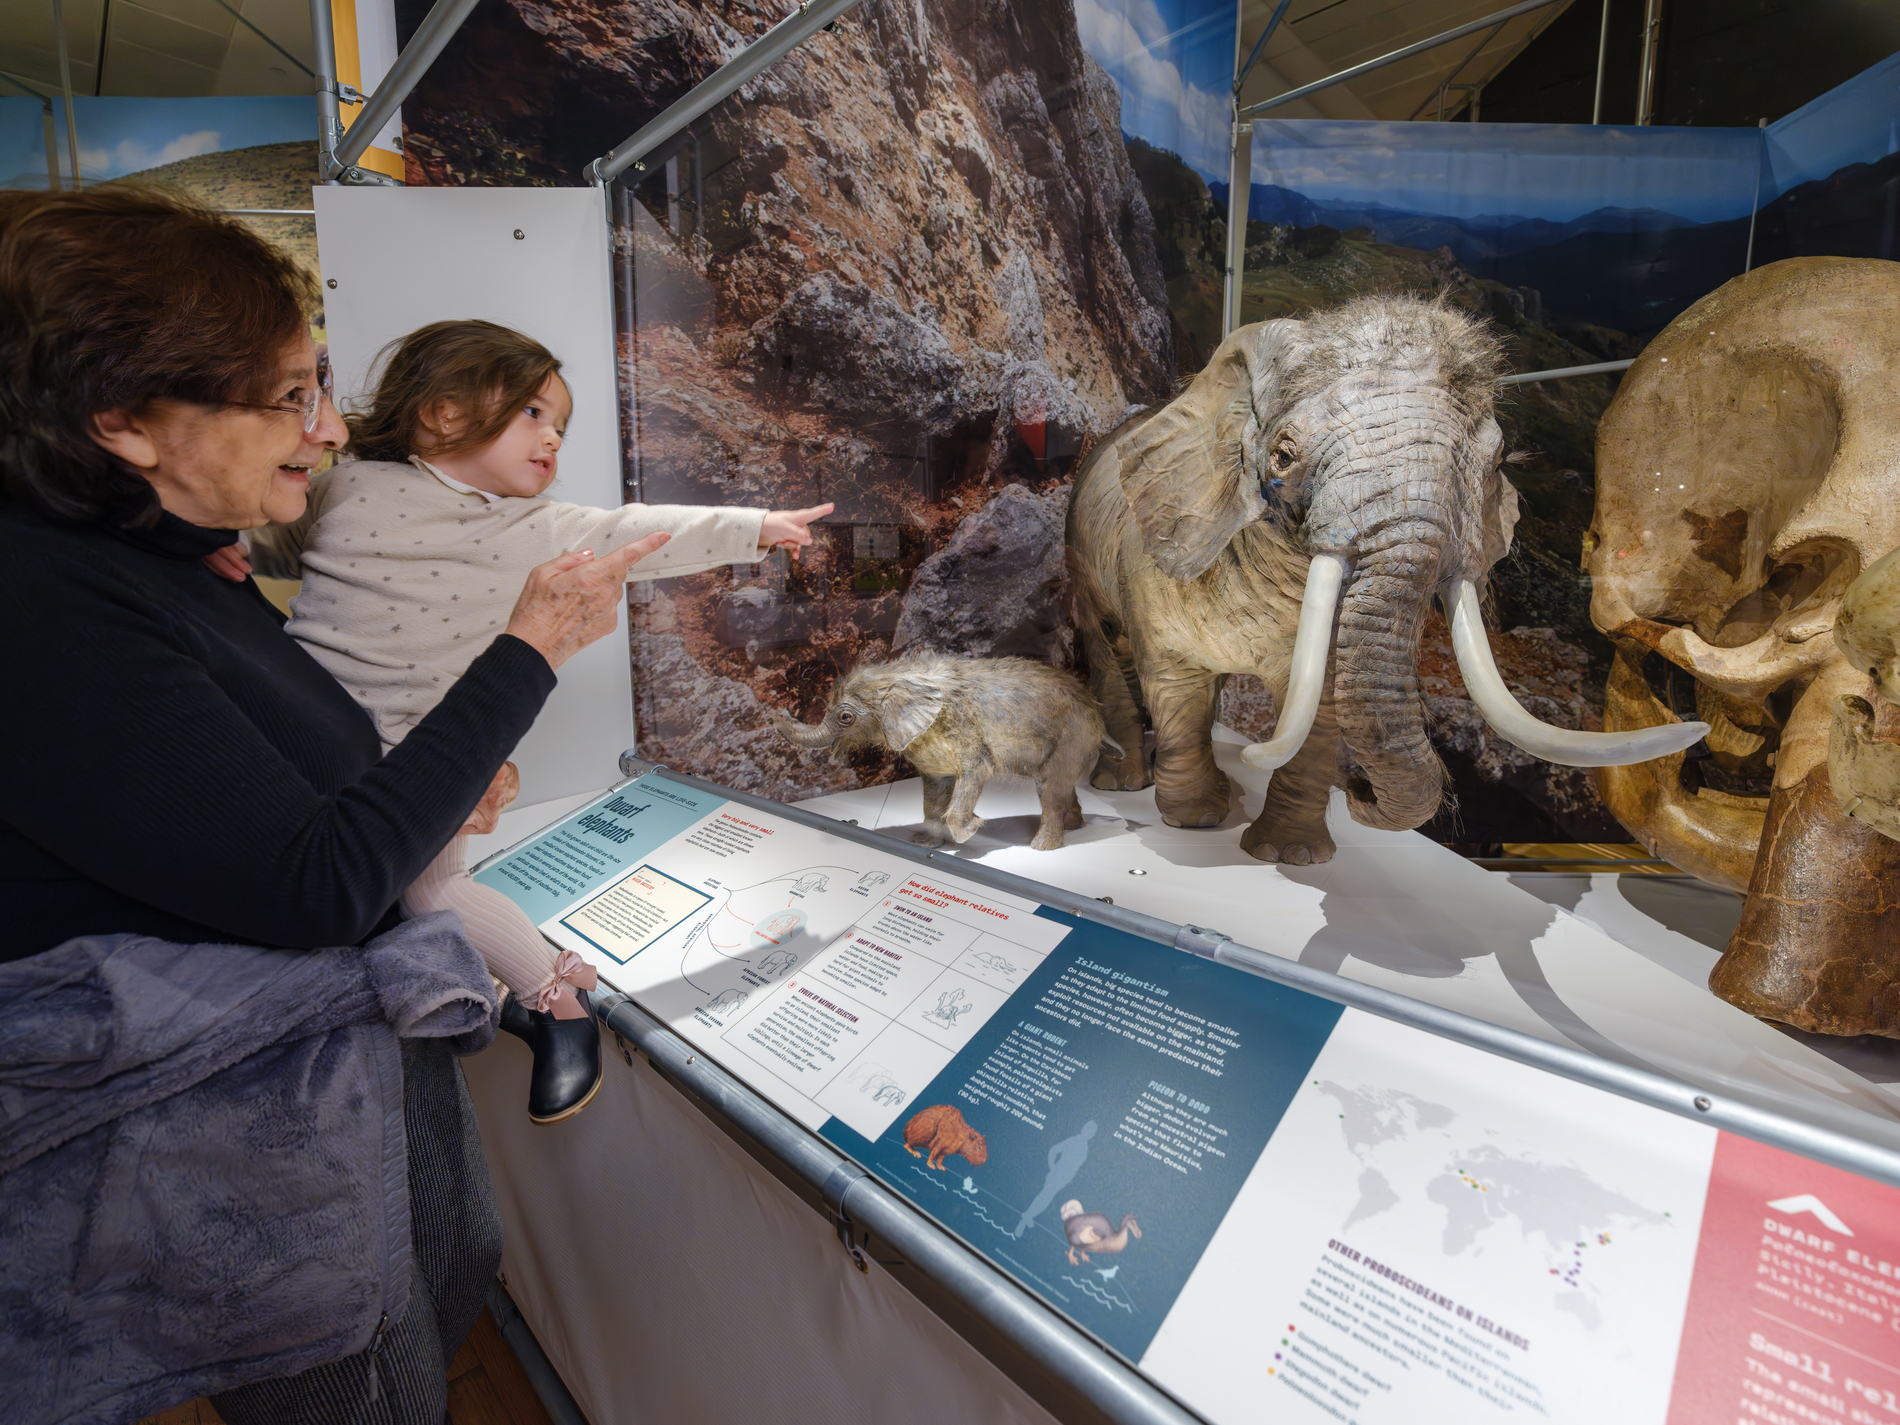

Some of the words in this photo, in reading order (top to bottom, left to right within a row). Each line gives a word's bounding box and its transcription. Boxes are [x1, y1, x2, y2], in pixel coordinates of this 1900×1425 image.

[603, 795, 651, 818] Dwarf
[577, 811, 635, 844] elephants
[758, 827, 775, 835] small
[907, 880, 921, 888] How
[920, 885, 936, 893] did
[934, 890, 968, 905] elephant
[968, 902, 1009, 920] relatives
[916, 913, 932, 923] ISLAND
[922, 896, 949, 908] small?
[849, 944, 869, 955] Compared
[856, 937, 871, 946] ADAPT
[882, 950, 902, 961] HABITAT
[1074, 956, 1112, 974] Island
[1110, 971, 1169, 997] gigantism
[790, 994, 801, 1002] When
[800, 1000, 816, 1011] ancient
[815, 1009, 836, 1022] elephants
[834, 1020, 846, 1028] gave
[844, 1025, 858, 1035] birth
[798, 987, 814, 998] EVOLVE
[817, 997, 837, 1011] NATURAL
[834, 1007, 859, 1023] SELECTION
[1034, 1003, 1068, 1021] ancestors
[1068, 1018, 1081, 1028] did.
[1054, 981, 1080, 996] species,
[1081, 991, 1112, 1009] however,
[1114, 1006, 1134, 1017] often
[1134, 1013, 1166, 1030] become
[1166, 1026, 1192, 1042] bigger,
[1194, 1038, 1205, 1046] as
[1206, 1042, 1226, 1056] they
[1067, 966, 1077, 974] On
[1077, 970, 1103, 985] islands,
[1104, 980, 1117, 990] big
[1116, 986, 1144, 1000] species
[1145, 996, 1164, 1007] tend
[1173, 1007, 1206, 1024] become
[1206, 1021, 1240, 1037] smaller
[1069, 977, 1086, 988] they
[1085, 984, 1106, 995] adapt
[1116, 995, 1129, 1004] the
[1129, 1000, 1158, 1015] limited
[1157, 1011, 1177, 1023] food
[1176, 1020, 1205, 1035] supply.
[1206, 1031, 1241, 1049] Smaller
[1023, 1023, 1043, 1035] GIANT
[1042, 1031, 1067, 1046] RODENT
[1040, 996, 1056, 1005] and
[1054, 1001, 1071, 1012] they
[1070, 1008, 1080, 1016] no
[1080, 1012, 1104, 1026] longer
[1104, 1022, 1121, 1034] face
[1122, 1030, 1136, 1040] the
[1136, 1037, 1158, 1049] same
[1157, 1046, 1200, 1067] predators
[1200, 1063, 1223, 1077] their
[1047, 989, 1072, 1002] exploit
[1071, 998, 1106, 1016] resources
[1106, 1013, 1120, 1022] not
[1120, 1019, 1155, 1036] available
[1155, 1034, 1167, 1042] on
[1167, 1038, 1182, 1048] the
[1183, 1045, 1224, 1067] mainland,
[993, 1049, 1014, 1061] island
[1050, 1076, 1062, 1085] for
[1005, 1035, 1019, 1045] like
[1018, 1043, 1041, 1056] rodents
[1042, 1053, 1057, 1063] tend
[1063, 1065, 1076, 1073] get
[1029, 1057, 1040, 1065] the
[1040, 1062, 1072, 1081] Caribbean
[1044, 1046, 1063, 1057] small
[1062, 1054, 1089, 1070] animals
[1141, 1091, 1174, 1110] Although
[1175, 1107, 1192, 1119] they
[1192, 1116, 1207, 1126] are
[1207, 1123, 1228, 1136] much
[1148, 1080, 1176, 1098] PIGEON
[1176, 1092, 1187, 1103] TO
[1187, 1098, 1210, 1114] DODO
[1124, 1115, 1152, 1132] species
[1154, 1129, 1171, 1142] that
[1172, 1138, 1191, 1151] flew
[1192, 1148, 1202, 1157] to
[1130, 1106, 1149, 1120] from
[1159, 1122, 1197, 1144] ancestral
[1197, 1140, 1226, 1158] pigeon
[1135, 1098, 1161, 1116] bigger,
[1162, 1113, 1184, 1126] dodos
[1185, 1123, 1217, 1142] evolved
[1113, 1131, 1122, 1139] in
[1123, 1136, 1136, 1146] the
[1136, 1142, 1162, 1160] Indian
[1163, 1157, 1188, 1174] Ocean.
[1119, 1123, 1143, 1138] what's
[1143, 1136, 1159, 1146] now
[1159, 1143, 1202, 1171] Mauritius,
[1764, 1218, 1835, 1252] DWARF
[1328, 1239, 1361, 1262] OTHER
[1362, 1256, 1453, 1310] PROBOSCIDEANS
[1456, 1305, 1473, 1321] ON
[1476, 1316, 1528, 1350] ISLANDS
[1749, 1332, 1833, 1383] Small
